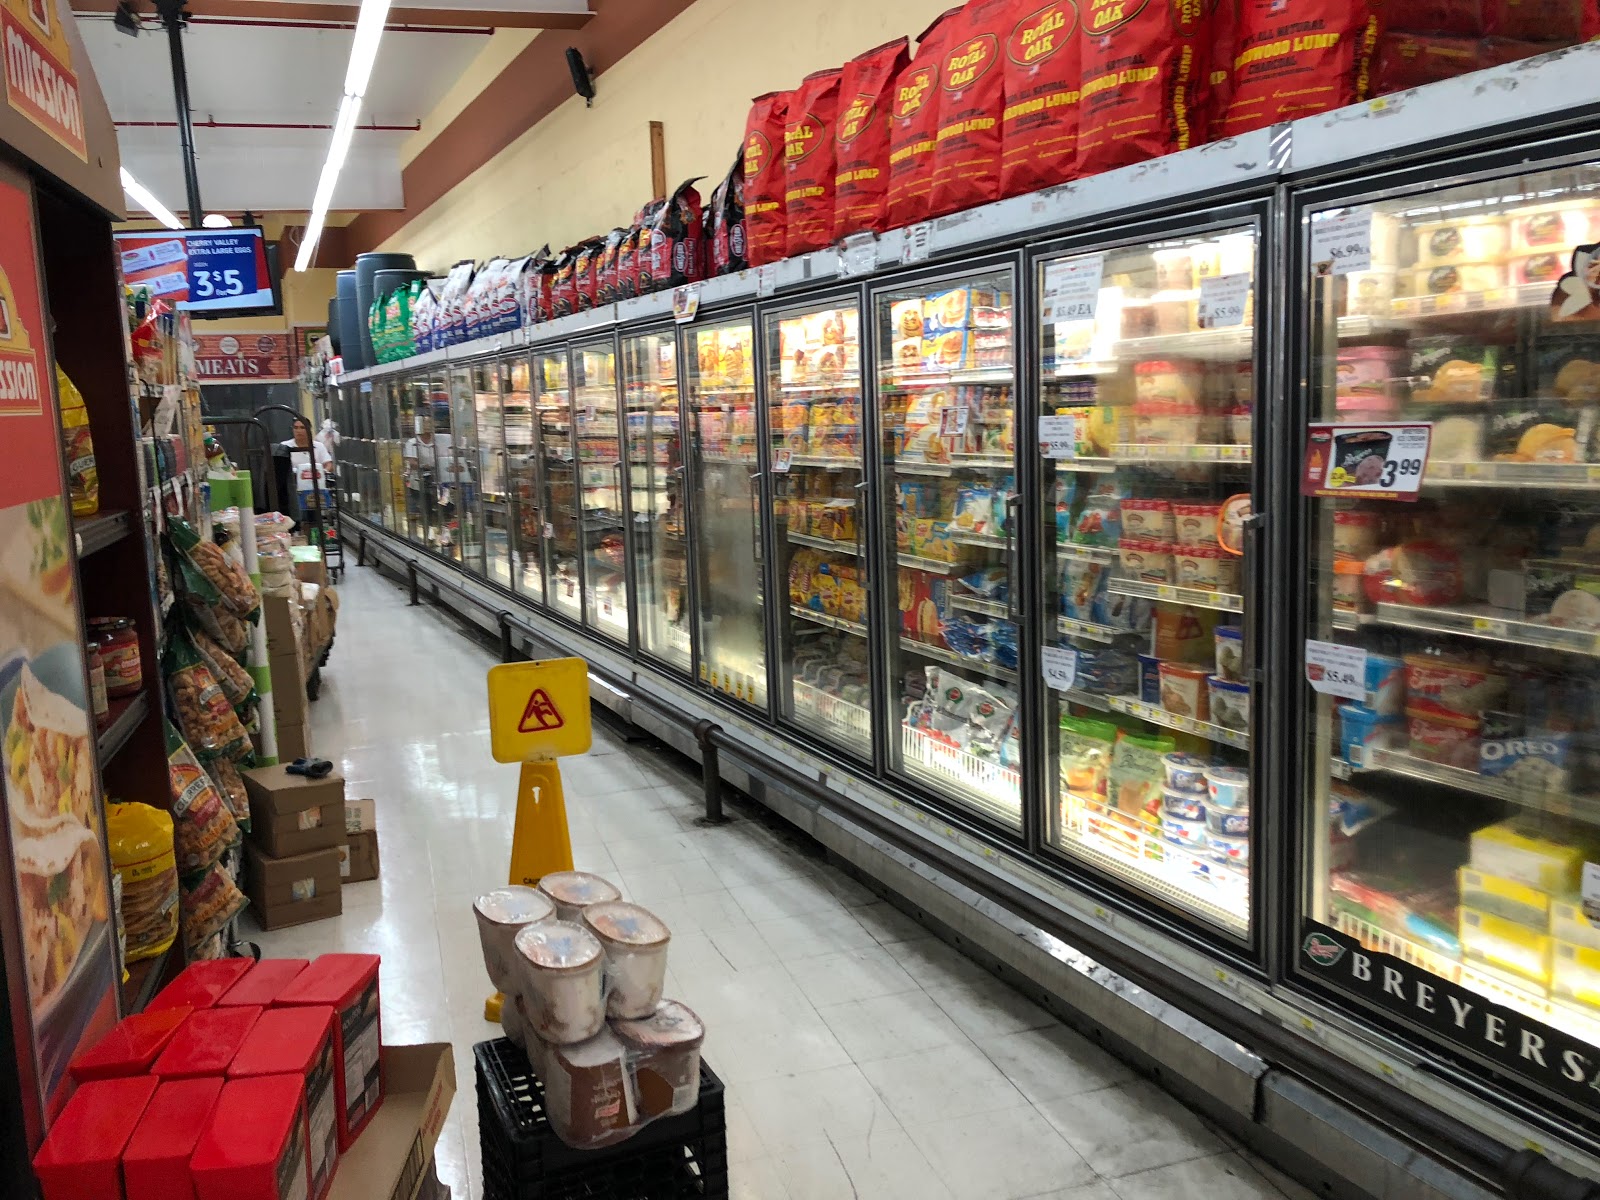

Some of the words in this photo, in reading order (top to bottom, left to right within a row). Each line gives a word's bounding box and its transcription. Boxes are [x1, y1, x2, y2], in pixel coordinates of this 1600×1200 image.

[1093, 2, 1126, 28] OAK
[1020, 12, 1065, 45] ROYAL
[1024, 34, 1054, 61] OAK
[1293, 33, 1340, 52] LUMP
[948, 46, 986, 71] ROYAL
[1178, 45, 1193, 82] LUMP
[6, 25, 82, 141] MISSION
[950, 66, 976, 86] OAK
[1119, 67, 1158, 84] LUMP
[899, 76, 929, 101] ROYAL
[1046, 91, 1080, 108] LUMP
[901, 93, 922, 115] OAK
[965, 118, 995, 132] LUMP
[912, 141, 937, 155] LUMP
[854, 168, 880, 179] LUMP
[186, 239, 213, 247] CHERRY
[214, 238, 239, 246] VALLEY
[188, 247, 211, 256] EXTRA
[212, 247, 234, 255] LARGE
[193, 270, 215, 297] 3
[196, 359, 259, 375] MEATS
[0, 360, 37, 400] SSION
[1380, 460, 1398, 488] 3
[1399, 458, 1421, 476] 99
[1479, 740, 1559, 761] OREO
[1352, 949, 1590, 1083] BREYERS
